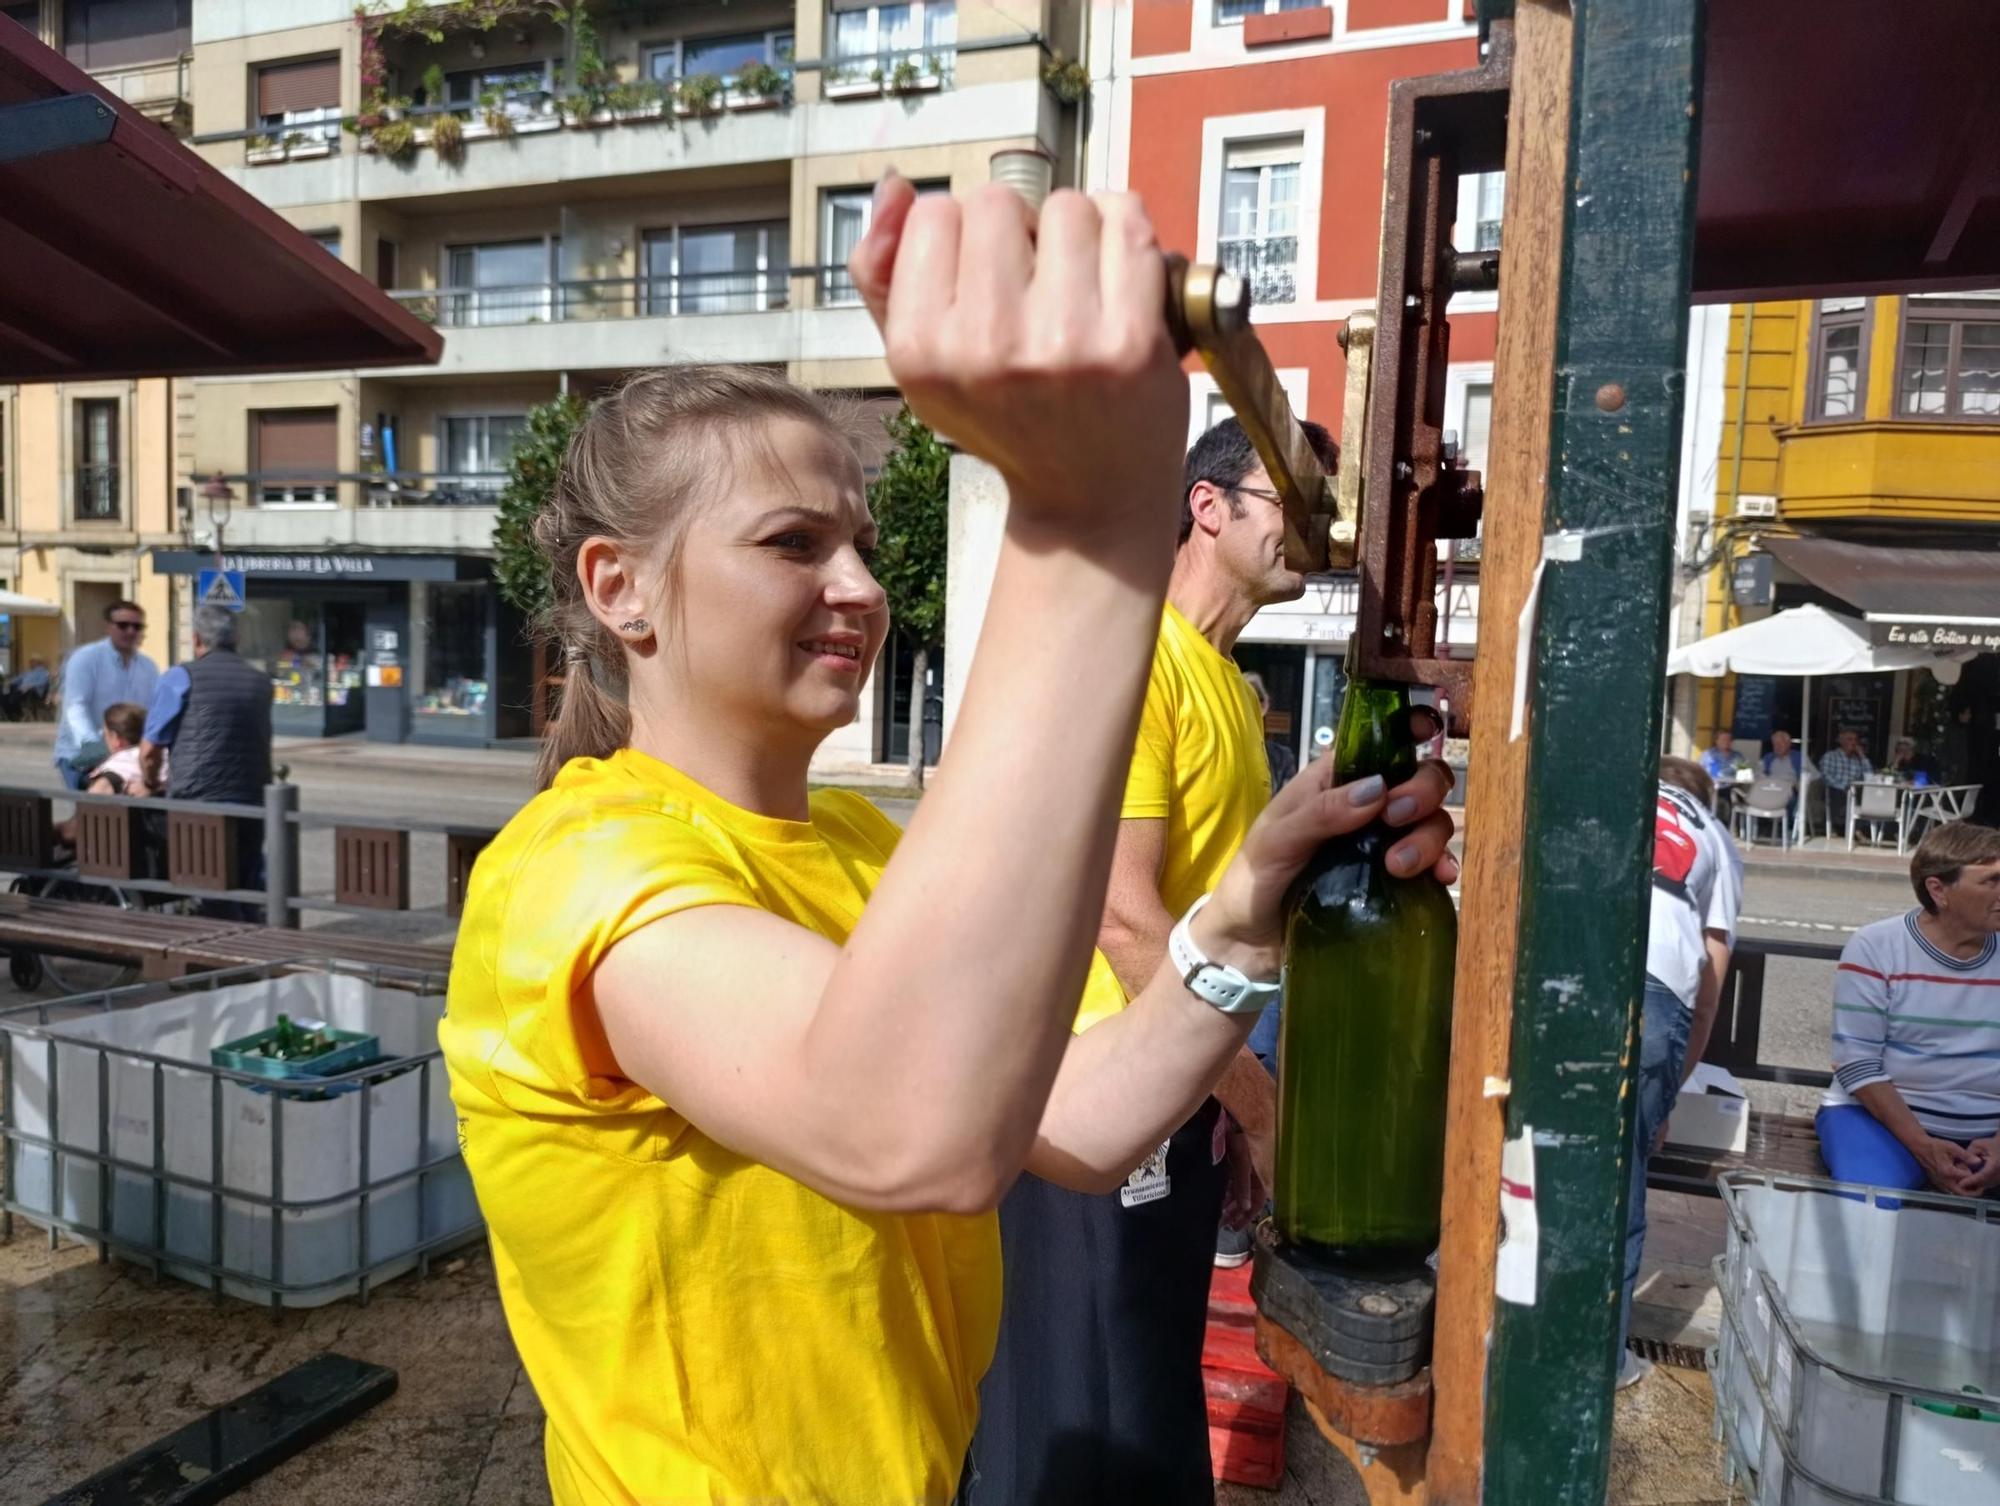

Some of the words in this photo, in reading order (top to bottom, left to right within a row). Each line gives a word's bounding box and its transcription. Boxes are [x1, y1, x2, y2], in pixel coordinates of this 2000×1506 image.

[295, 557, 312, 571] DE
[314, 556, 332, 573] LA
[332, 556, 374, 572] VILLA
[1316, 584, 1359, 616] VIL
[1888, 625, 1906, 642] En
[1932, 627, 1967, 644] Botica
[1984, 636, 2000, 651] exp
